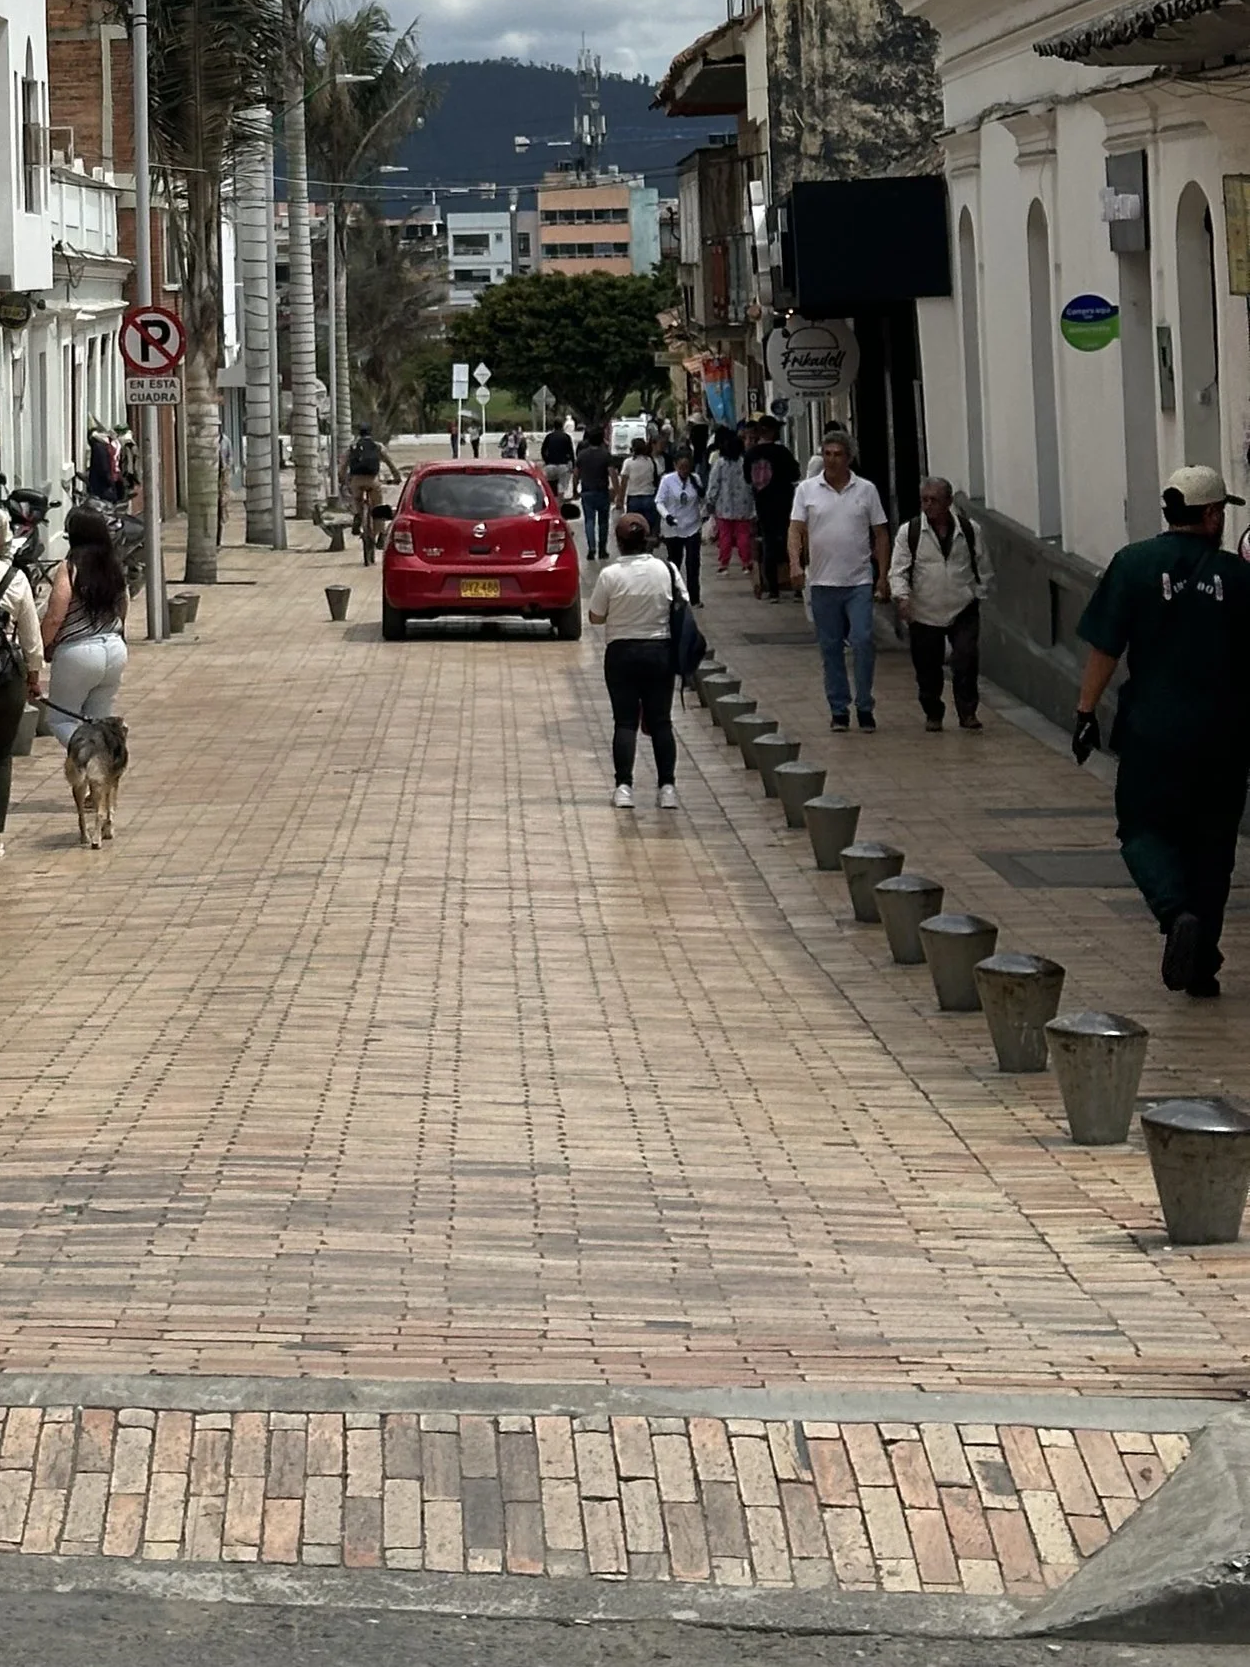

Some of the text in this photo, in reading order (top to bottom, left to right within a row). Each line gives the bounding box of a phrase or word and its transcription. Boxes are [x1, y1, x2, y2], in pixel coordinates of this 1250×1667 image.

[130, 379, 177, 389] EN ESTA
[130, 392, 177, 403] CUADRA
